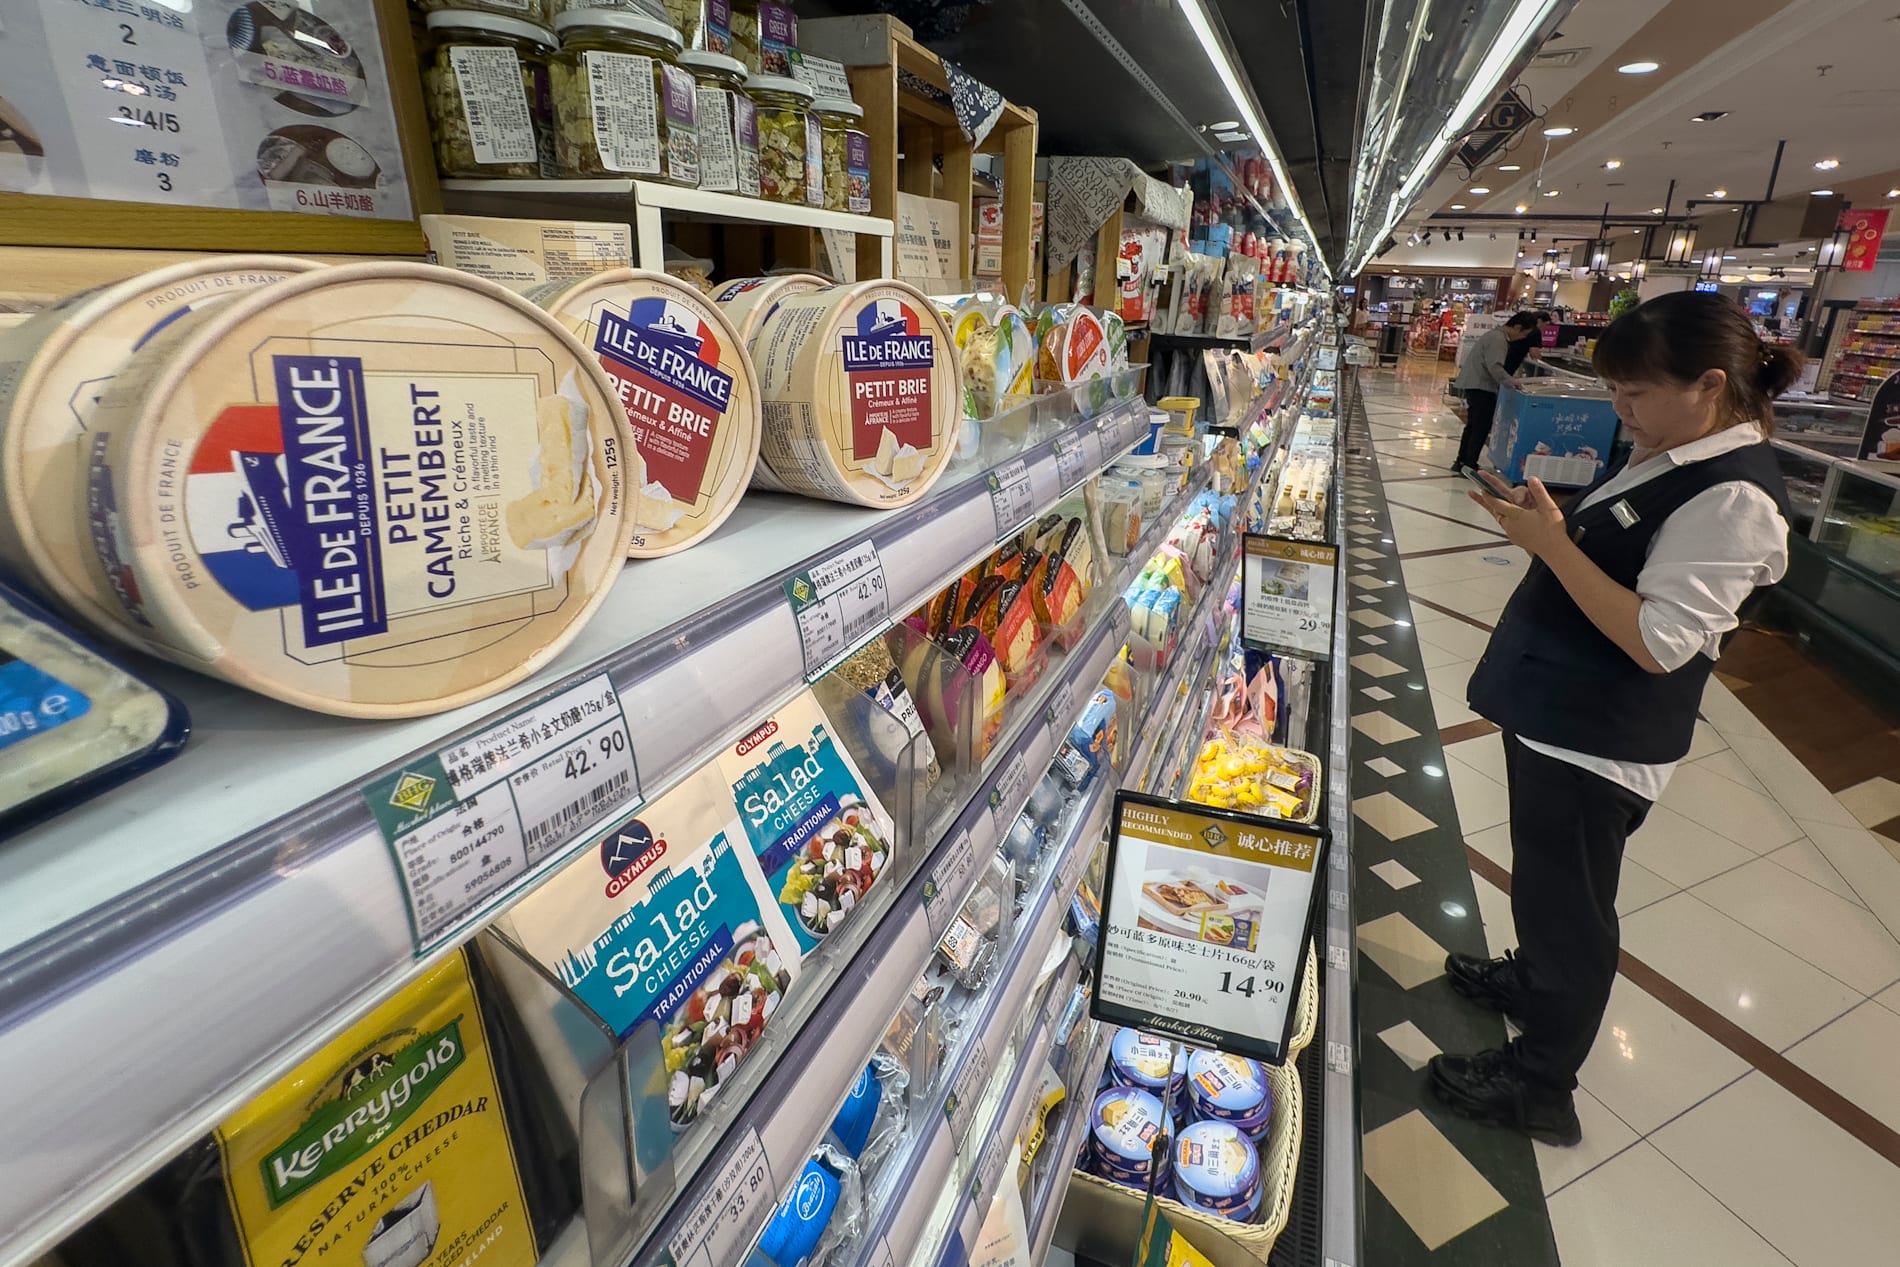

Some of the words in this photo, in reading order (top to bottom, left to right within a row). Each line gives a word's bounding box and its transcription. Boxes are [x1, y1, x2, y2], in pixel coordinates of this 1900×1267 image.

[119, 24, 138, 45] 2
[768, 19, 788, 37] GREEK
[157, 172, 172, 192] 3
[297, 189, 374, 212] 6.山羊奶酪
[148, 279, 209, 309] PRODUIT
[216, 276, 234, 287] DE
[603, 319, 639, 355] ILE
[637, 341, 659, 366] DE
[660, 348, 729, 402] FRANCE
[846, 340, 868, 361] ILE
[869, 345, 883, 360] DE
[884, 341, 932, 360] FRANCE
[650, 367, 671, 383] DEPUIS
[856, 380, 895, 399] PETIT
[898, 378, 927, 396] BRIE
[465, 403, 475, 421] and
[868, 399, 894, 408] Crémeux
[895, 397, 900, 406] &
[901, 396, 917, 404] Affiné
[468, 423, 478, 445] taste
[478, 416, 488, 448] texture
[623, 405, 657, 428] rémeux
[659, 420, 666, 431] &
[668, 425, 692, 442] Affiné
[667, 402, 712, 438] BRIE
[289, 366, 354, 524] FRANCE
[451, 420, 468, 492] Crémeux
[488, 435, 497, 452] rind
[604, 438, 617, 470] 125g
[159, 439, 183, 499] FRANCE
[353, 463, 367, 489] 1936
[470, 446, 480, 481] flavorful
[480, 449, 491, 483] melting
[491, 453, 500, 473] thin
[380, 447, 418, 544] PETIT
[410, 383, 456, 599] CAMEMBERT
[473, 481, 481, 491] A
[897, 487, 910, 497] 125g
[158, 504, 177, 523] DE
[356, 494, 371, 536] DEPUIS
[455, 498, 469, 511] &
[477, 503, 487, 515] DE
[609, 500, 617, 516] Net
[320, 529, 358, 569] DE
[456, 515, 473, 560] Riche
[159, 530, 199, 590] PRODUIT
[313, 573, 365, 633] ILE
[858, 574, 883, 601] 42.90
[476, 724, 510, 750] Product
[737, 723, 777, 754] OLYMPUS
[541, 755, 563, 771] Retail
[565, 729, 625, 779] 42.90
[744, 753, 824, 828] Salad
[774, 785, 821, 830] CHEESE
[1122, 807, 1170, 826] HIGHLY
[462, 817, 485, 838] 合格
[782, 804, 832, 851] TRADITIONAL
[1120, 820, 1192, 842] RECOMMENDED
[449, 824, 505, 865] 800144790
[1237, 831, 1312, 861] 诚心推荐
[608, 842, 664, 894] OLYMPUS
[606, 873, 718, 998] Salad
[644, 920, 710, 994] CHEESE
[652, 942, 723, 1020] TRADITIONAL
[1217, 971, 1285, 999] 14.90
[1143, 1015, 1190, 1035] Market
[1189, 1024, 1224, 1042] Place
[271, 1036, 456, 1189] Kerrygold
[388, 1096, 489, 1162] CHEDDAR
[317, 1185, 399, 1257] NATURAL
[404, 1131, 460, 1182] CHEESE
[371, 1163, 409, 1196] 100%
[730, 1166, 765, 1223] 33.80
[465, 1200, 509, 1247] CHEDDAR
[436, 1230, 467, 1264] YEARS
